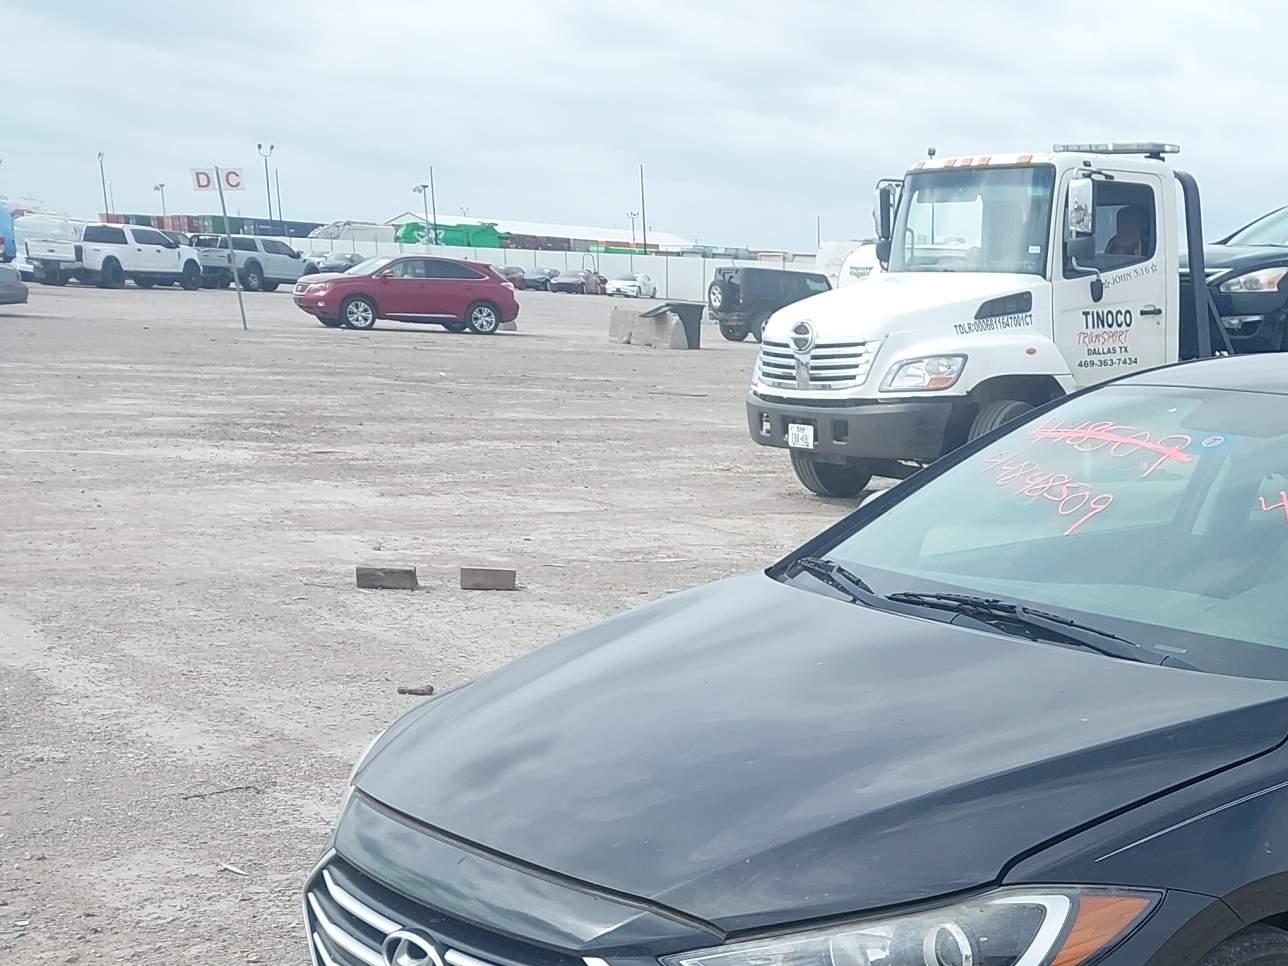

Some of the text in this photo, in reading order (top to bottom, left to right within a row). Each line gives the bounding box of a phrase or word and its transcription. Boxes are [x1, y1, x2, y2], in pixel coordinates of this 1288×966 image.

[195, 171, 211, 188] D
[225, 171, 240, 188] C
[1111, 272, 1132, 286] JOHN
[1082, 309, 1133, 330] TINOCO
[1087, 345, 1129, 356] DALLAS TX
[1077, 356, 1138, 369] 469-363-7434
